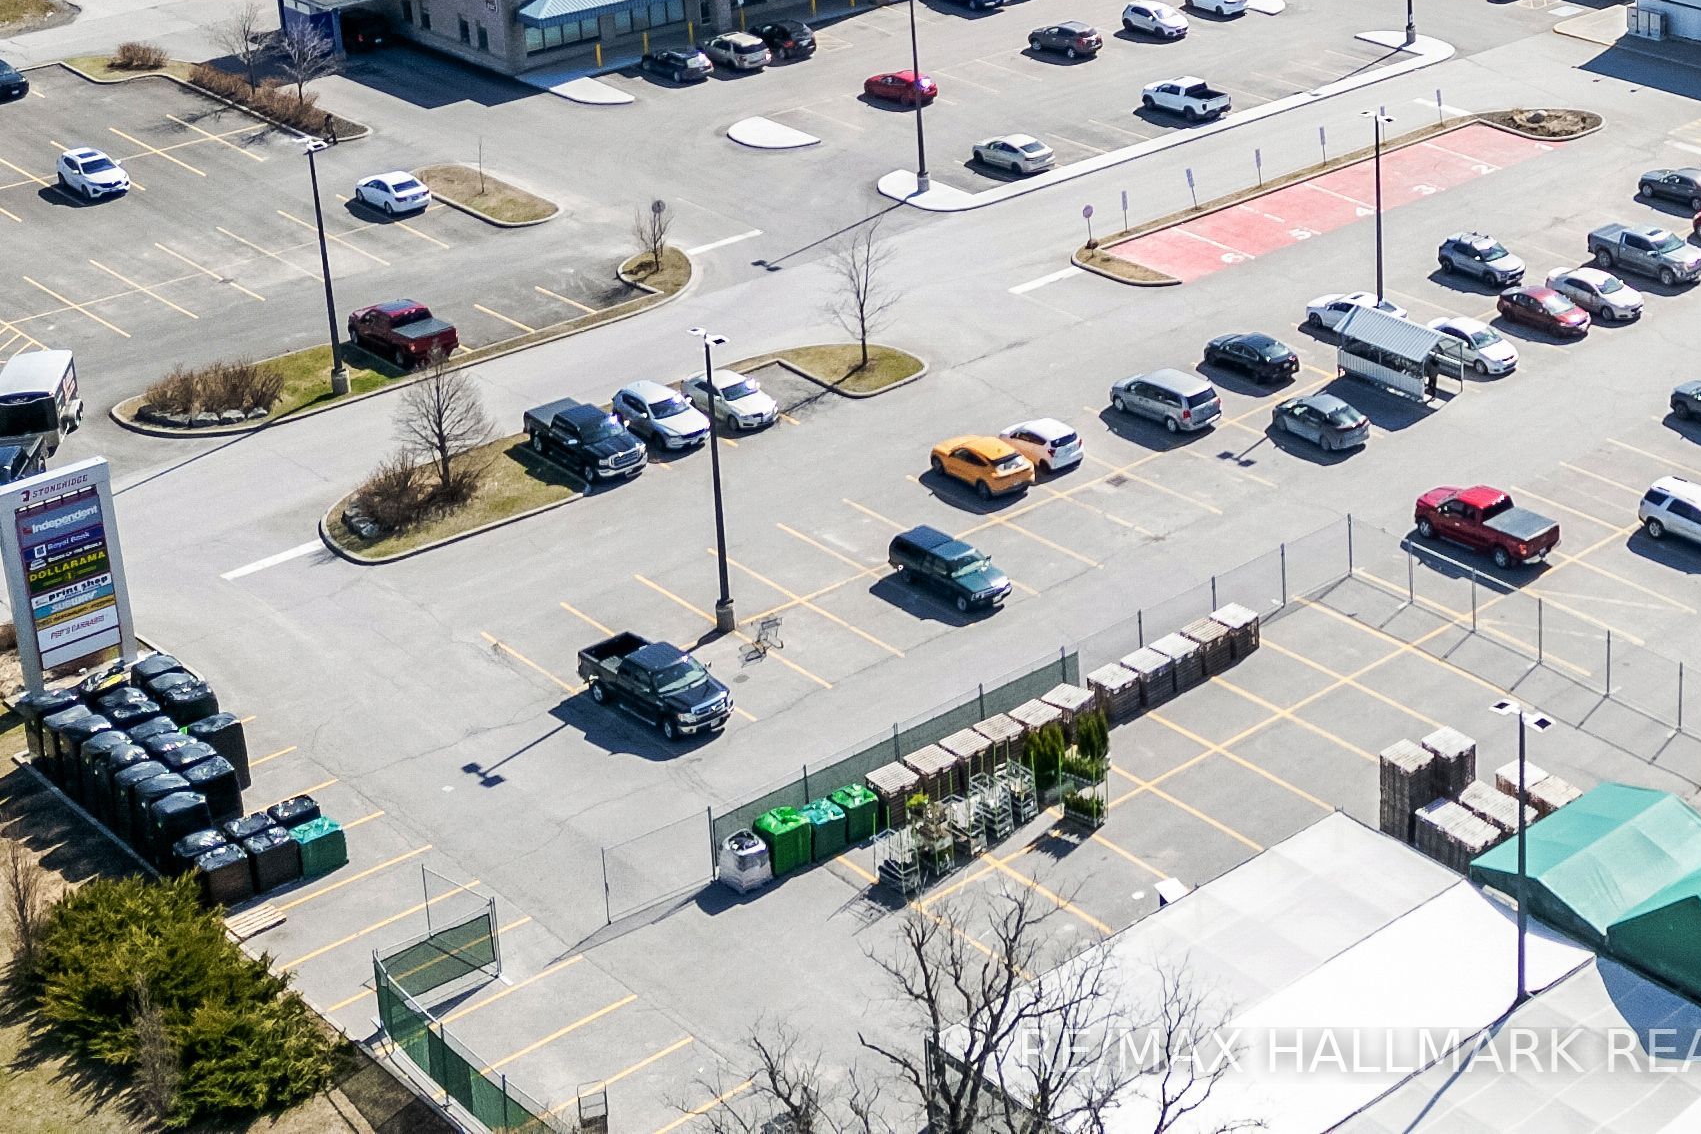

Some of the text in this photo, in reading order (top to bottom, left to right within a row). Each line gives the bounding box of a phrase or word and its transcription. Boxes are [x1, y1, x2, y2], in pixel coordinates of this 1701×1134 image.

[32, 474, 88, 498] STONERIDGE
[32, 505, 97, 534] Independent
[29, 550, 106, 582] DOLLARAMA
[48, 586, 78, 601] print
[81, 575, 108, 590] shop
